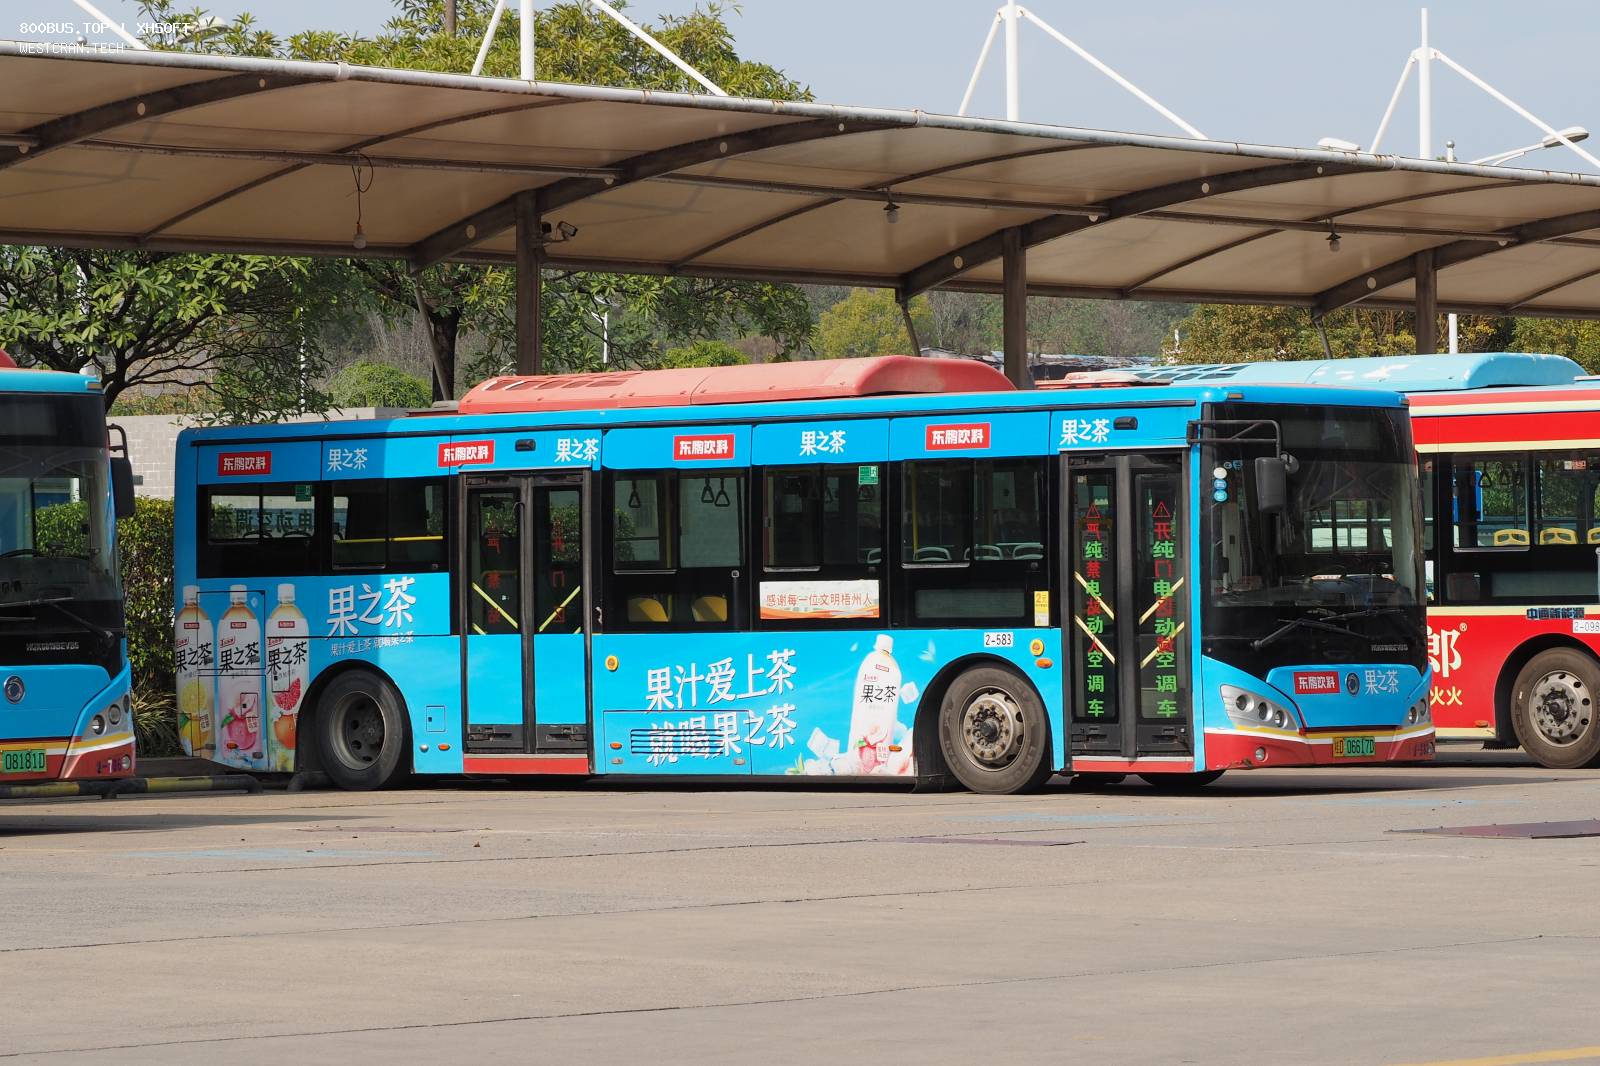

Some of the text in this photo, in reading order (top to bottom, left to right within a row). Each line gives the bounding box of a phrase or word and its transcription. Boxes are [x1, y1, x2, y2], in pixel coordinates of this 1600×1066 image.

[800, 430, 847, 457] 果之茶
[932, 429, 984, 445] 东鹏饮料
[1059, 418, 1110, 446] 果之茶
[327, 447, 368, 473] 果之茶
[443, 445, 489, 463] 东鹏饮料
[554, 438, 599, 463] 果之茶
[679, 439, 729, 456] 东鹏饮料
[223, 456, 266, 472] 东鹏饮料
[326, 576, 417, 640] 果之茶
[766, 593, 873, 607] 感谢每一位文明梧州人
[985, 634, 1012, 646] 2-583
[1085, 541, 1105, 718] 纯电动空调车
[1153, 541, 1178, 718] 纯电动空调车
[175, 641, 212, 673] 果之茶
[220, 641, 259, 674] 果之茶
[266, 640, 307, 675] 果之茶
[645, 648, 798, 714] 果汁爱上茶
[860, 684, 897, 703] 果之茶
[1298, 676, 1335, 690] 东鹏饮料
[1364, 669, 1399, 695] 果之茶
[5, 752, 45, 770] 08181D
